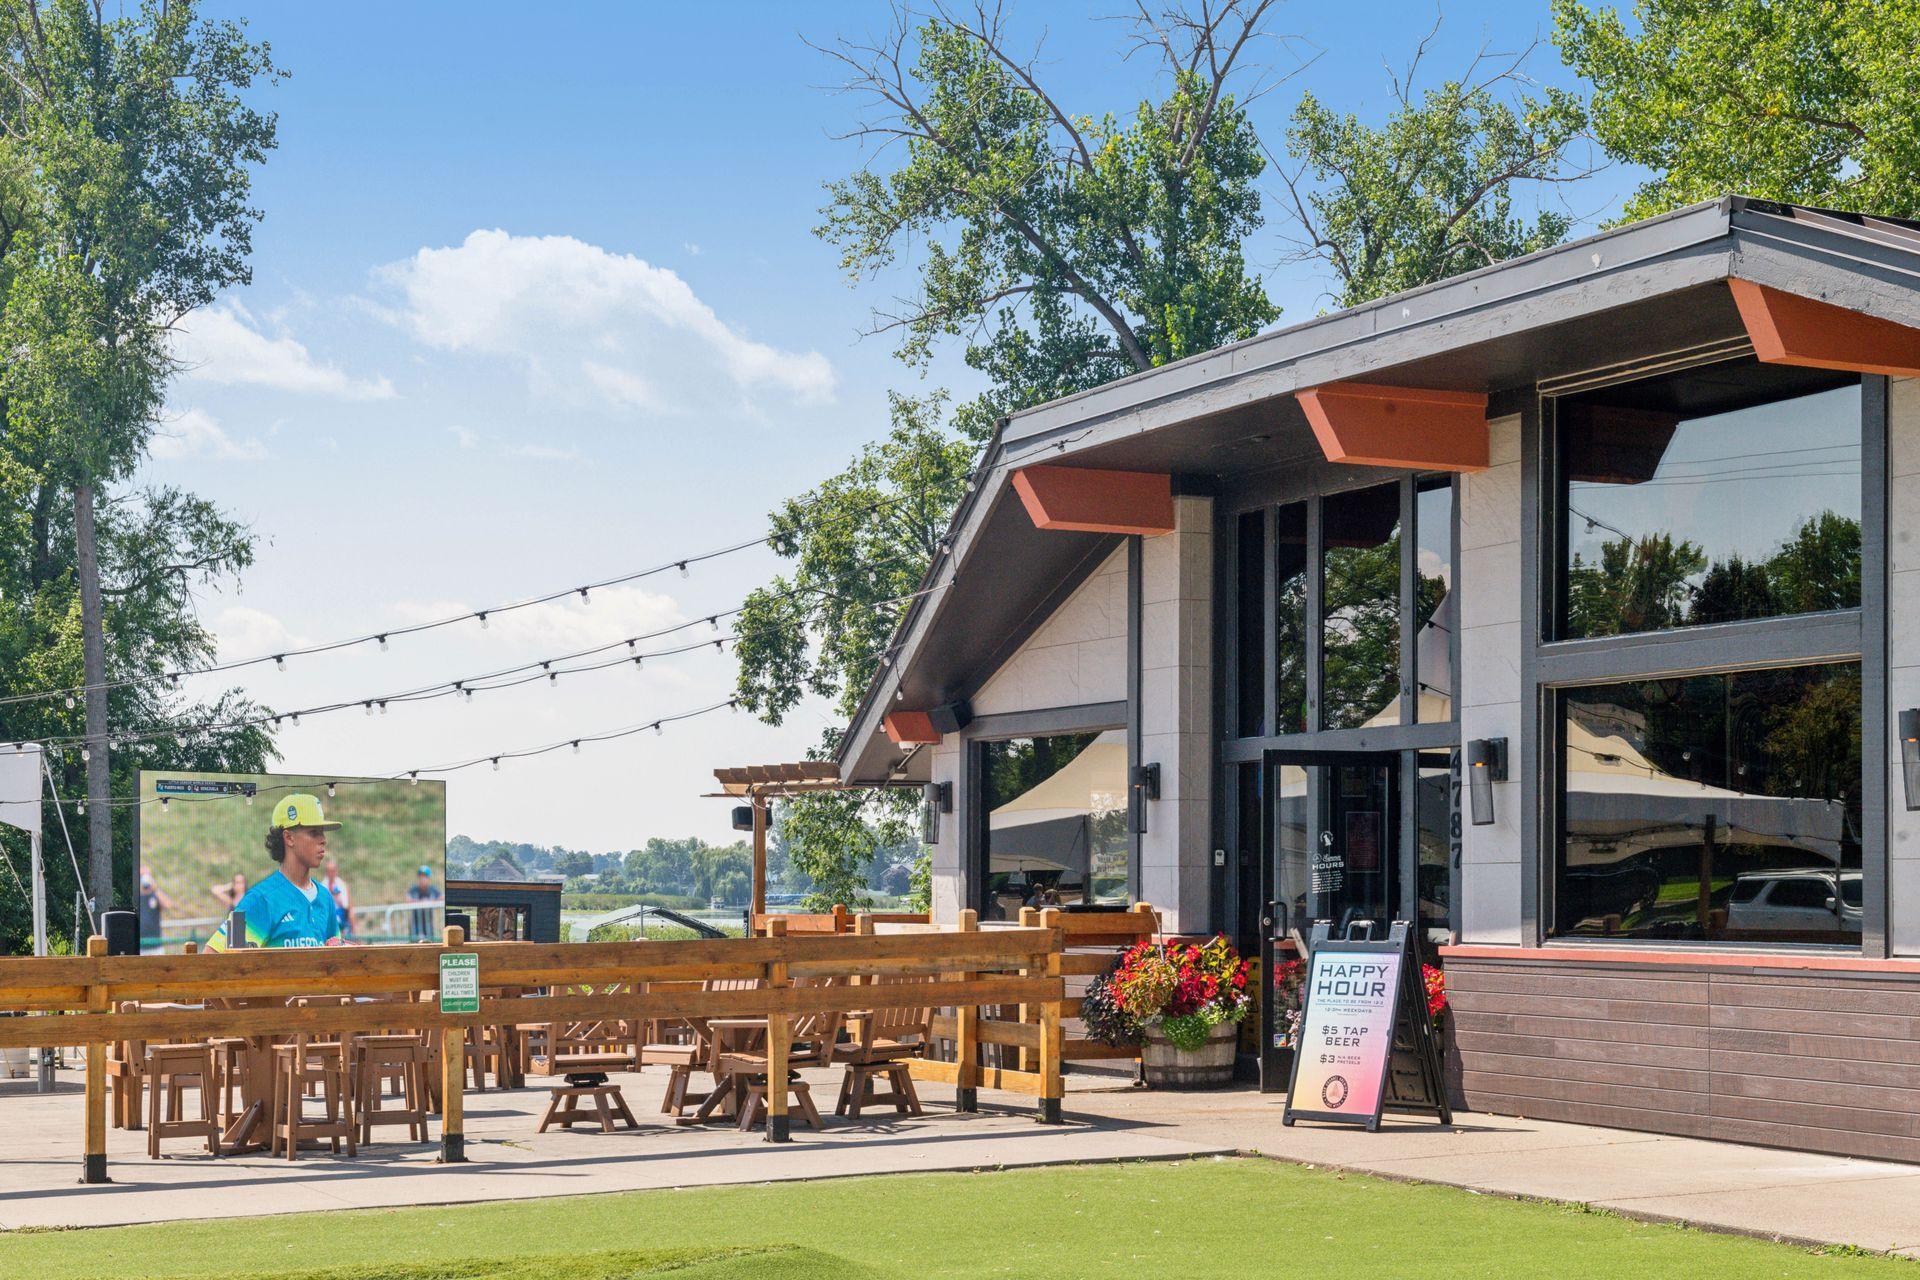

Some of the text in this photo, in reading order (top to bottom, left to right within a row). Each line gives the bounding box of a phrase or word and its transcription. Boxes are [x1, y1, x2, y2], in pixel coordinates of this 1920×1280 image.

[1451, 748, 1463, 869] 4787
[1312, 861, 1344, 870] HOURS
[1320, 964, 1389, 978] HAPPY
[1317, 980, 1386, 997] HOUR
[1322, 1025, 1369, 1036] $5 TAP
[1325, 1036, 1361, 1047] BEER
[1320, 1053, 1335, 1064] $3
